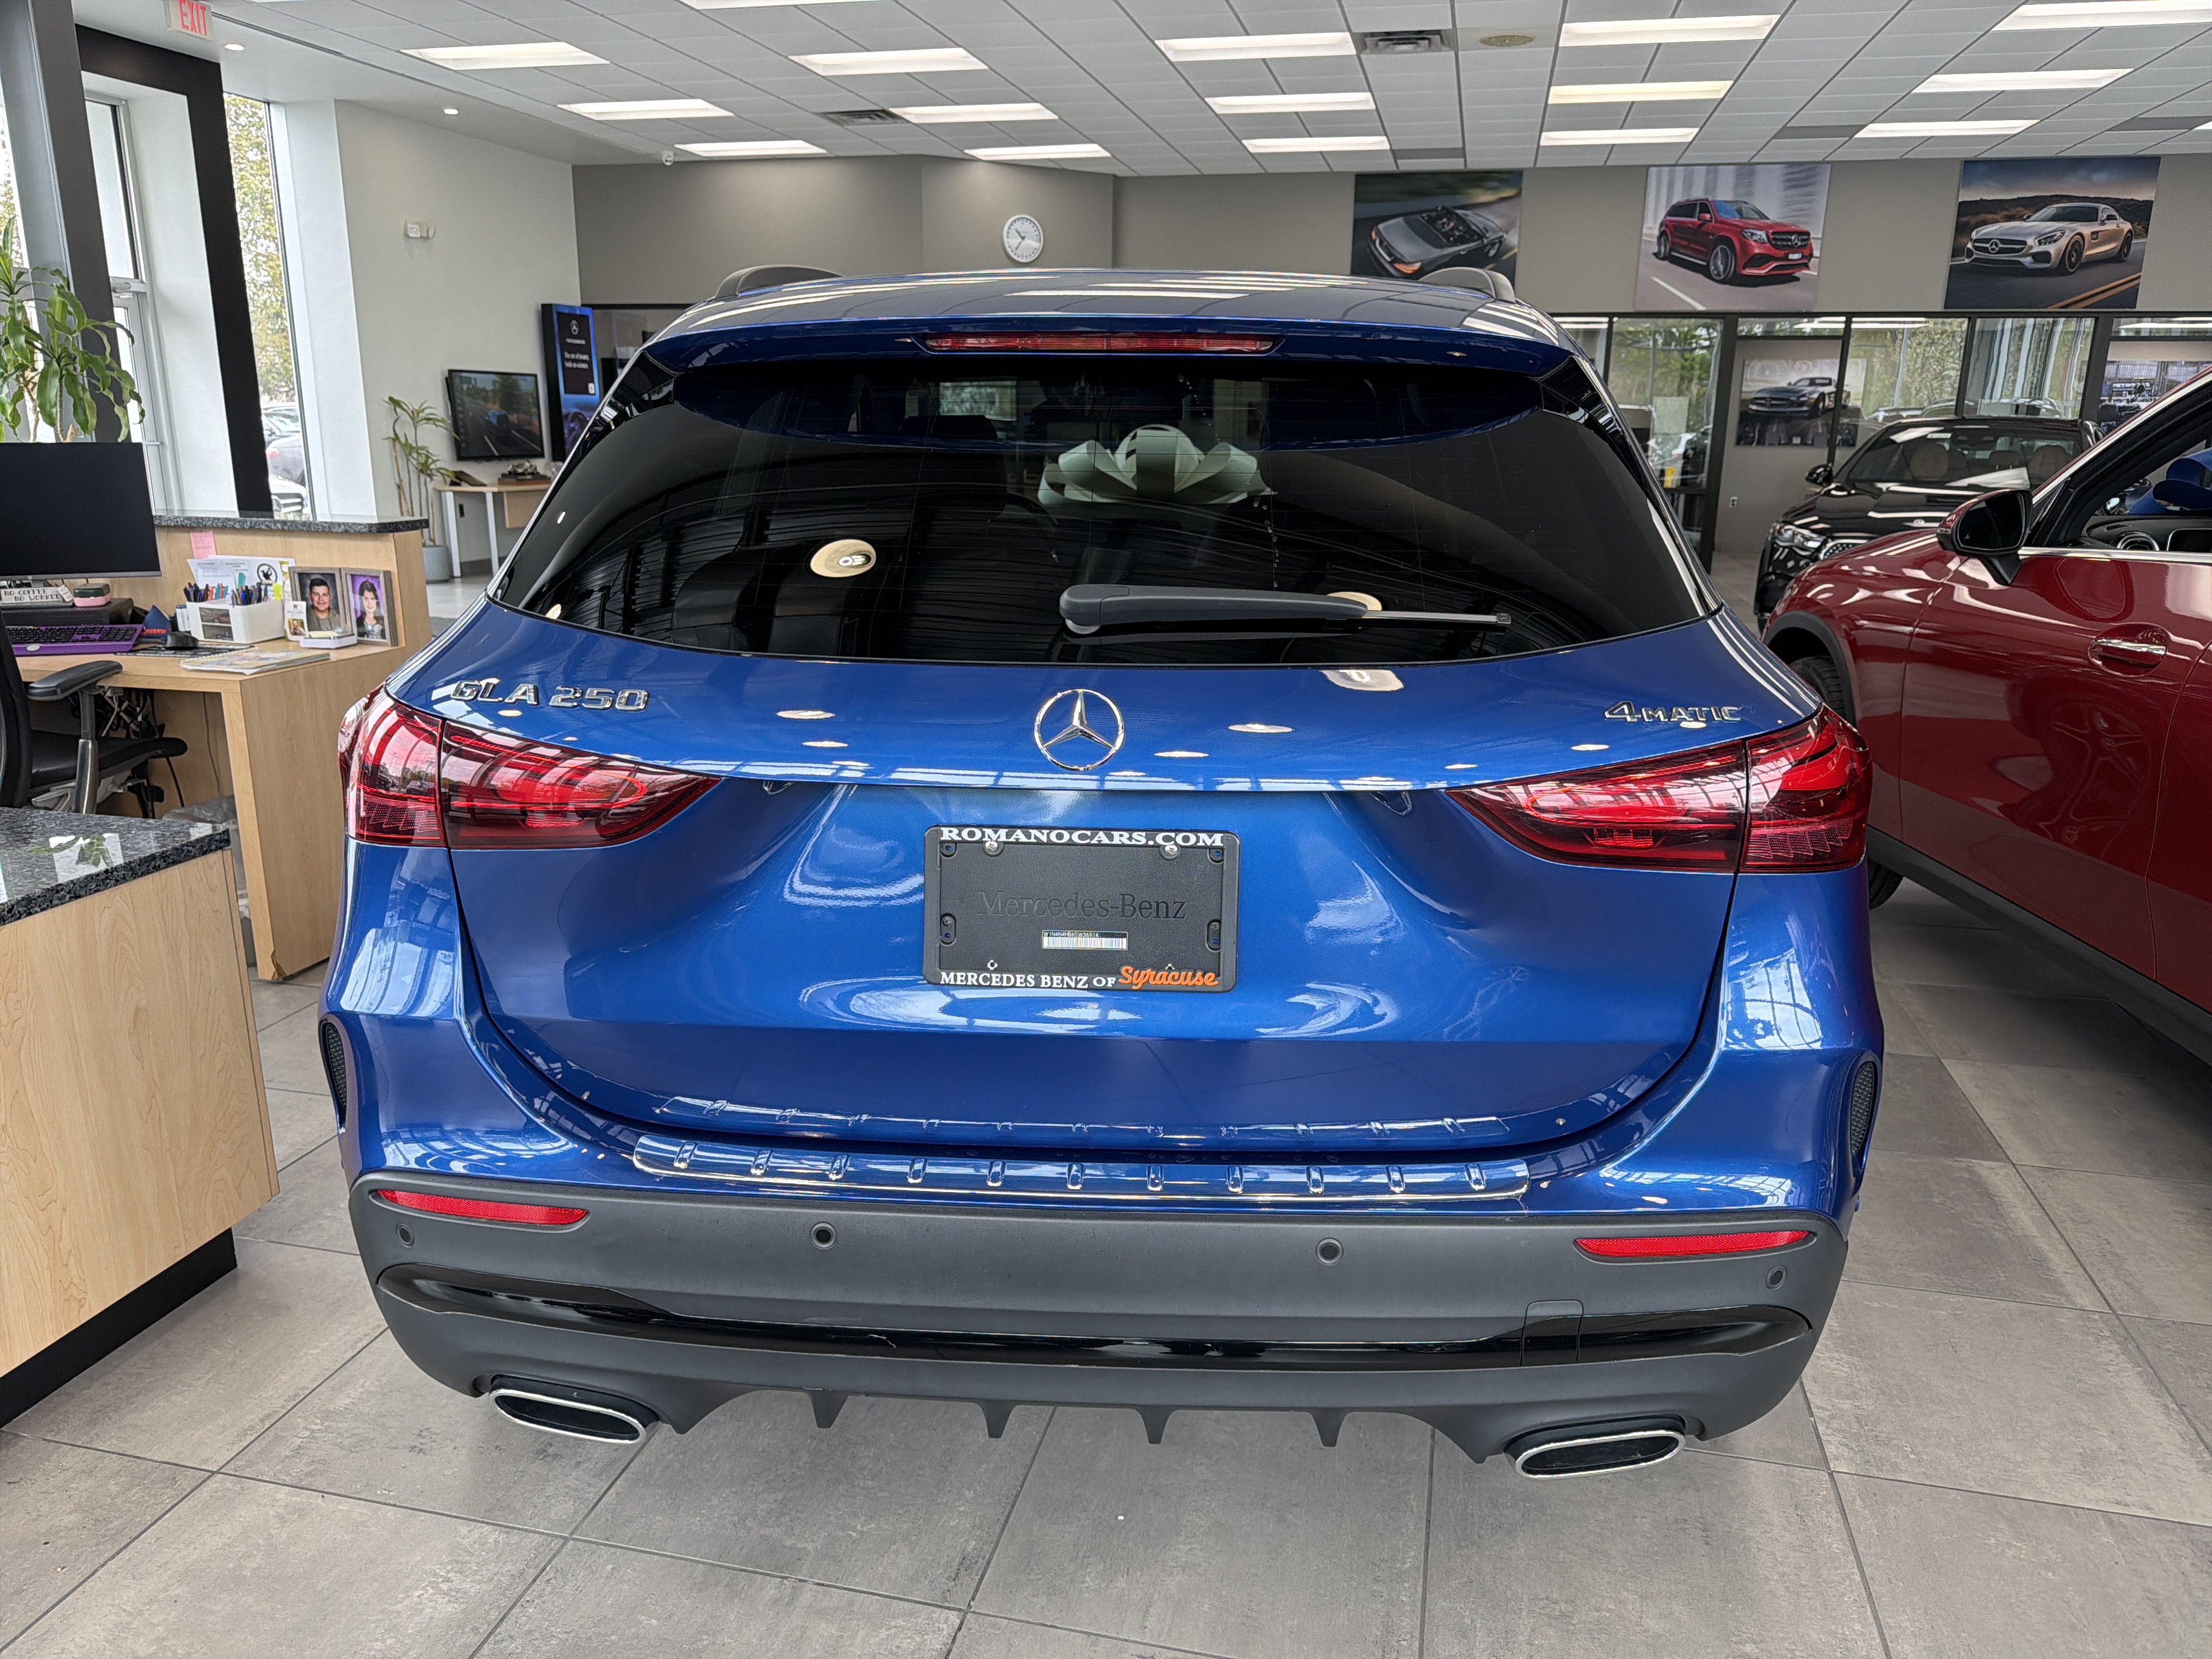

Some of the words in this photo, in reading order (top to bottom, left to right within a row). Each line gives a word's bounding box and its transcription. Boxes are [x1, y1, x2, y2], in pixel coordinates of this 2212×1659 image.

[178, 0, 207, 36] EXIT
[450, 680, 540, 706] GLA
[549, 686, 649, 712] 250
[1605, 701, 1741, 723] 4MATIC
[940, 827, 1224, 847] ROMANOCARS.COM
[977, 890, 1186, 919] Mercedes-Benz
[940, 971, 1035, 987] MERCEDES
[1040, 975, 1088, 988] BENZ
[1093, 977, 1115, 987] OF
[1118, 966, 1219, 990] Syracuse
